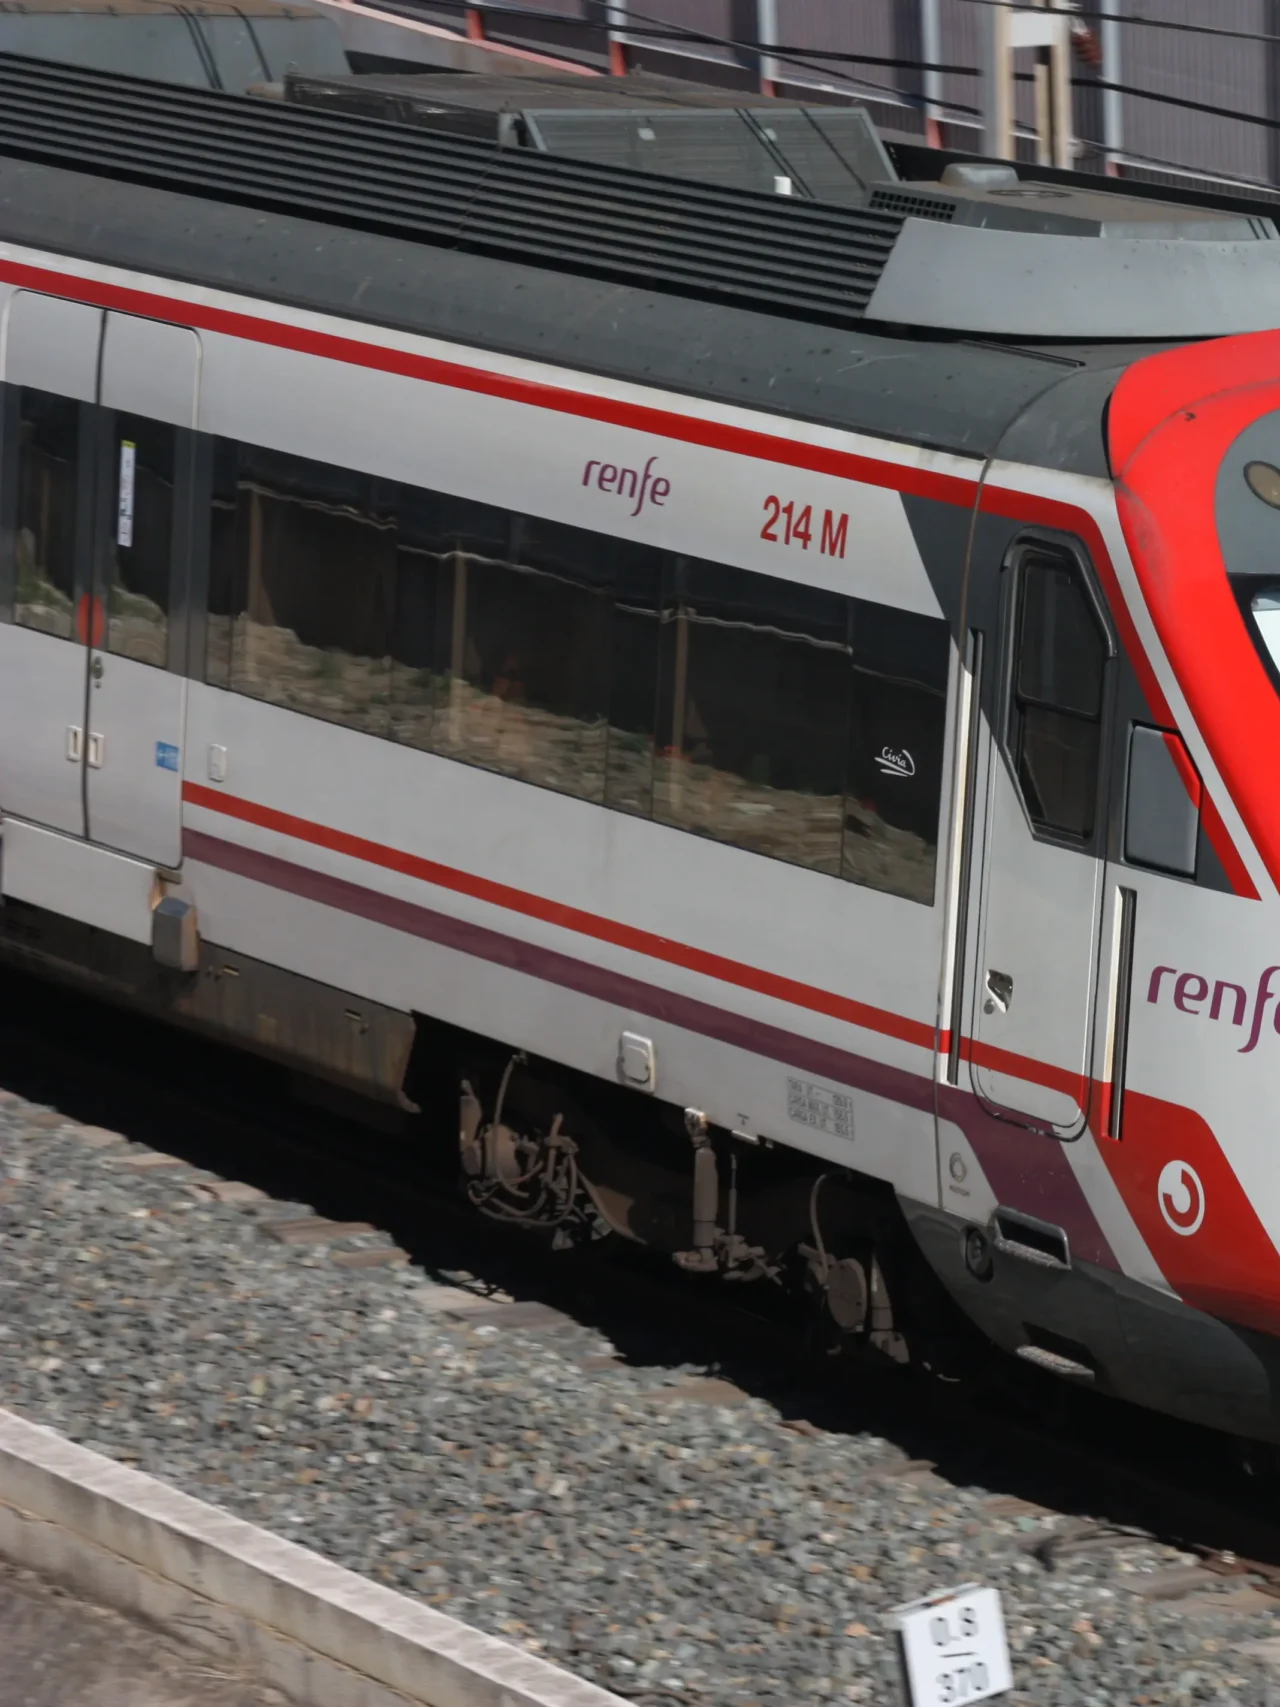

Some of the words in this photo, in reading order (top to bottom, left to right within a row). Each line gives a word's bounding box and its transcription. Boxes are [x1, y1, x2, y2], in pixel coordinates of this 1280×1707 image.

[582, 457, 671, 517] renfe
[760, 495, 812, 550] 214
[820, 509, 849, 559] M
[881, 746, 907, 768] Civia
